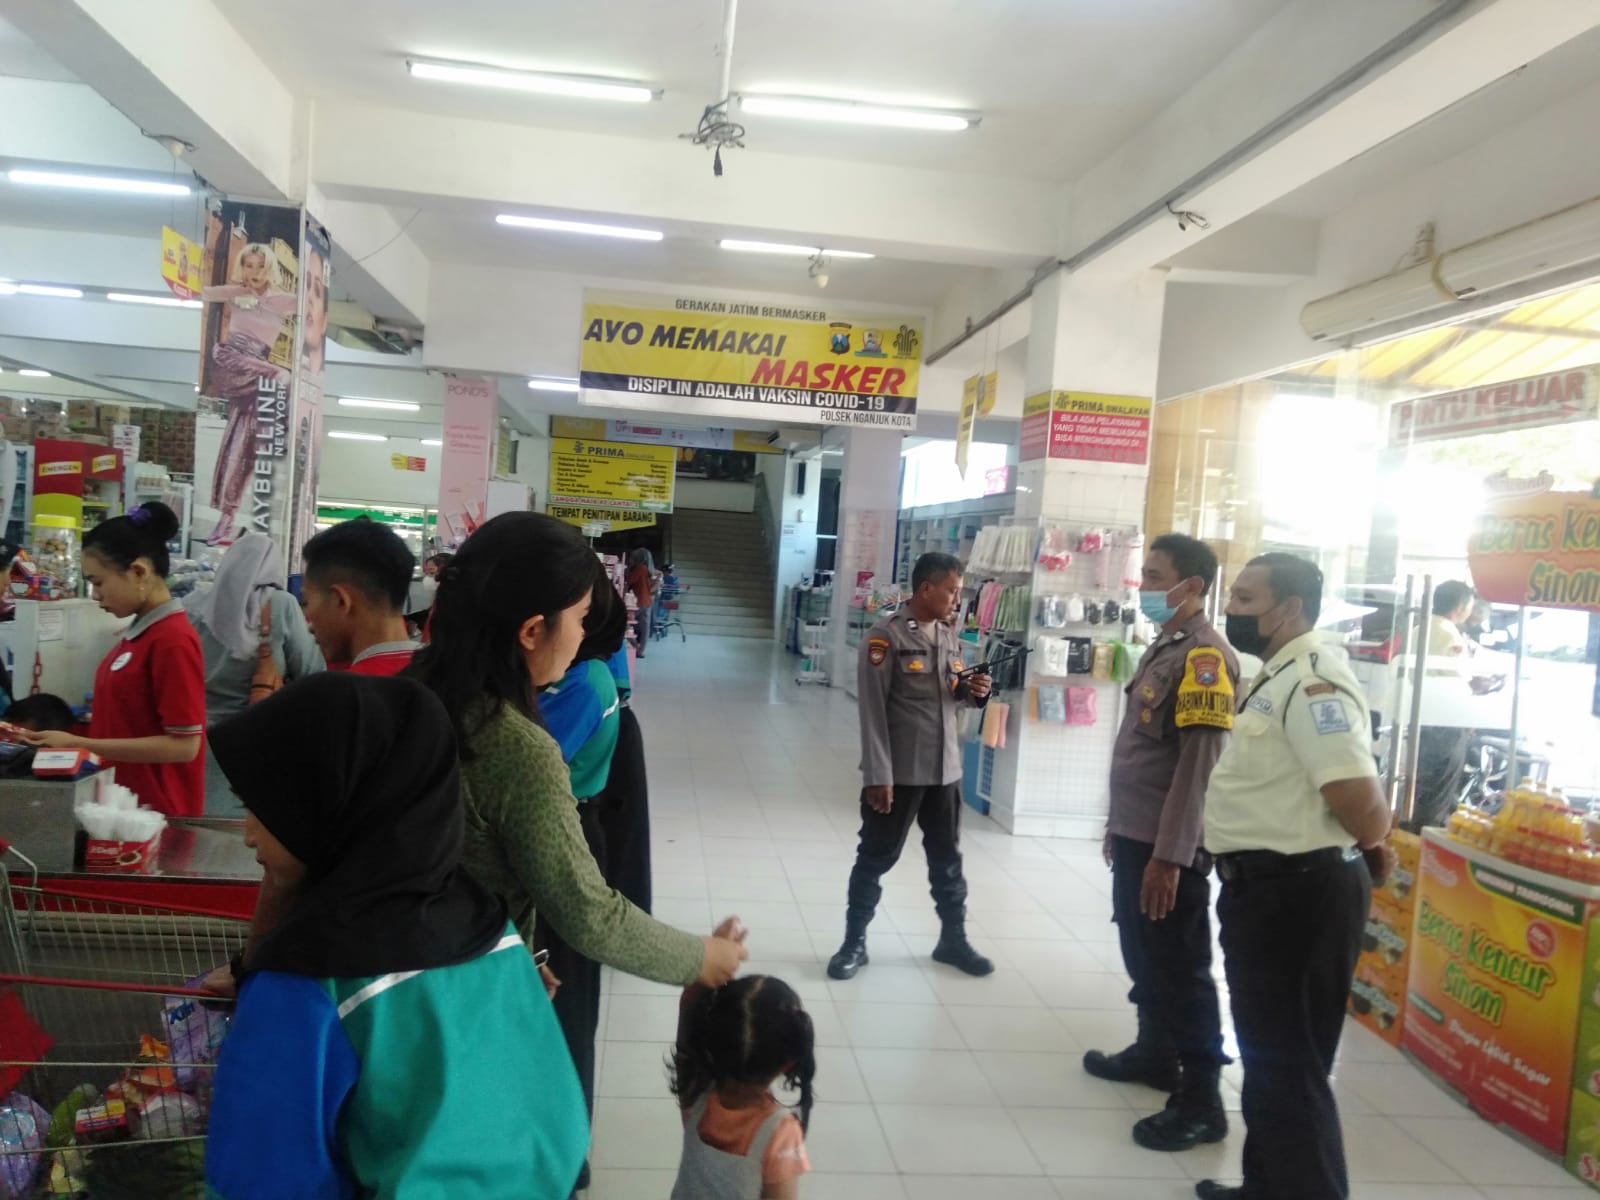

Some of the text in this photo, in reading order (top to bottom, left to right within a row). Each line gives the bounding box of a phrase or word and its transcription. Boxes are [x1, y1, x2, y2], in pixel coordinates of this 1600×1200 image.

[675, 299, 826, 322] GERAKAN JATIM BERMASKER
[584, 318, 788, 357] AYO MEMAKAI
[627, 377, 885, 411] DISIPLIN ADALAH VAKSIN COVID-19
[750, 358, 907, 396] MASKER
[1475, 371, 1587, 416] KELUAR
[274, 379, 289, 457] NEW YORK
[820, 409, 912, 427] POLSEK NGANJUK KOTA
[1071, 400, 1104, 412] PRIMA
[253, 375, 276, 537] AYBELLINE
[587, 446, 625, 458] PRIMA
[552, 507, 653, 523] TEMPAT PENITIPAN BARANG
[1466, 924, 1553, 995] Kencur
[1443, 961, 1503, 1025] Sinom
